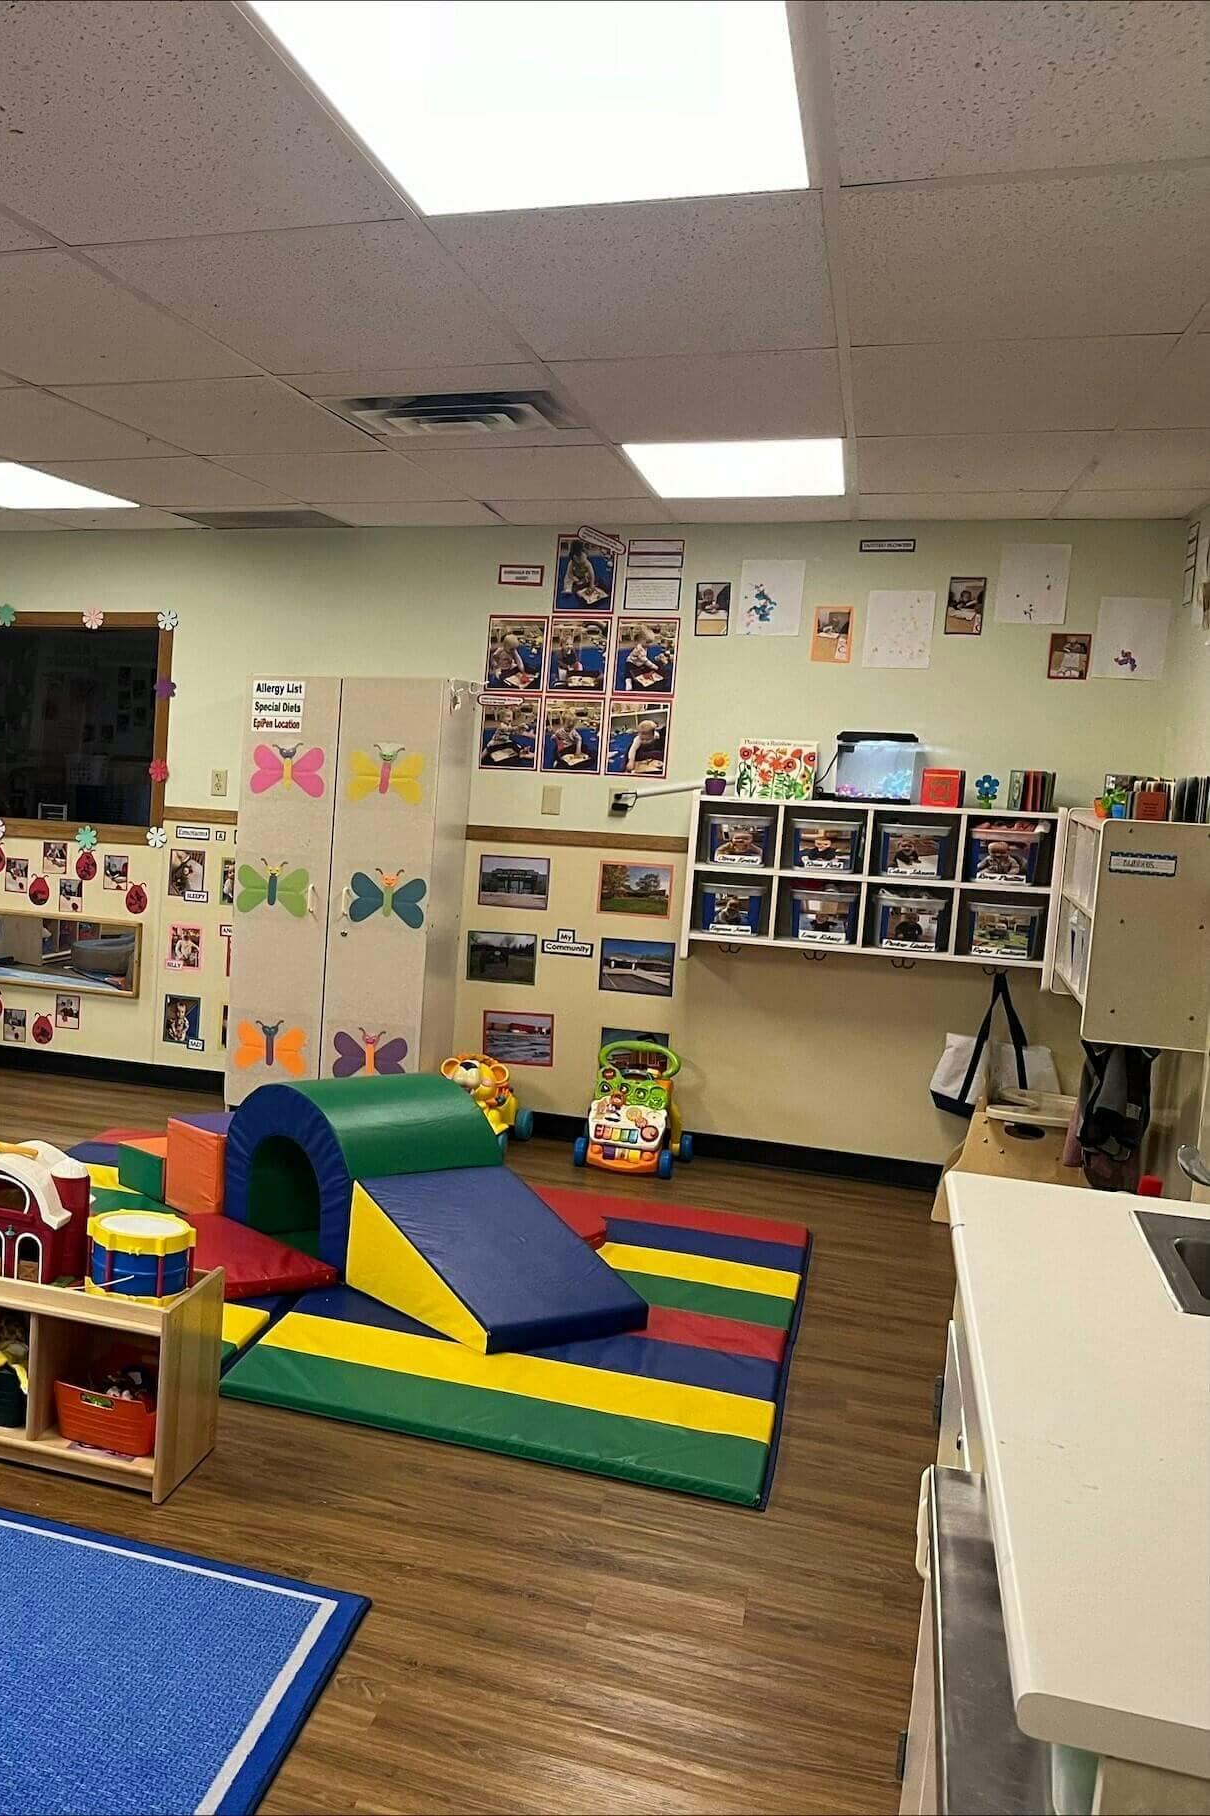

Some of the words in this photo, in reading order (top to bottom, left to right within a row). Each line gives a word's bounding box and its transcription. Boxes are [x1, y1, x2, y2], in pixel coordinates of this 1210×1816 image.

[256, 682, 284, 695] Allergy
[287, 683, 302, 694] List
[254, 701, 280, 713] Special
[282, 702, 301, 712] Diets
[253, 718, 273, 730] EpiPen
[274, 719, 300, 729] Location
[560, 933, 572, 941] My
[545, 943, 589, 953] Community
